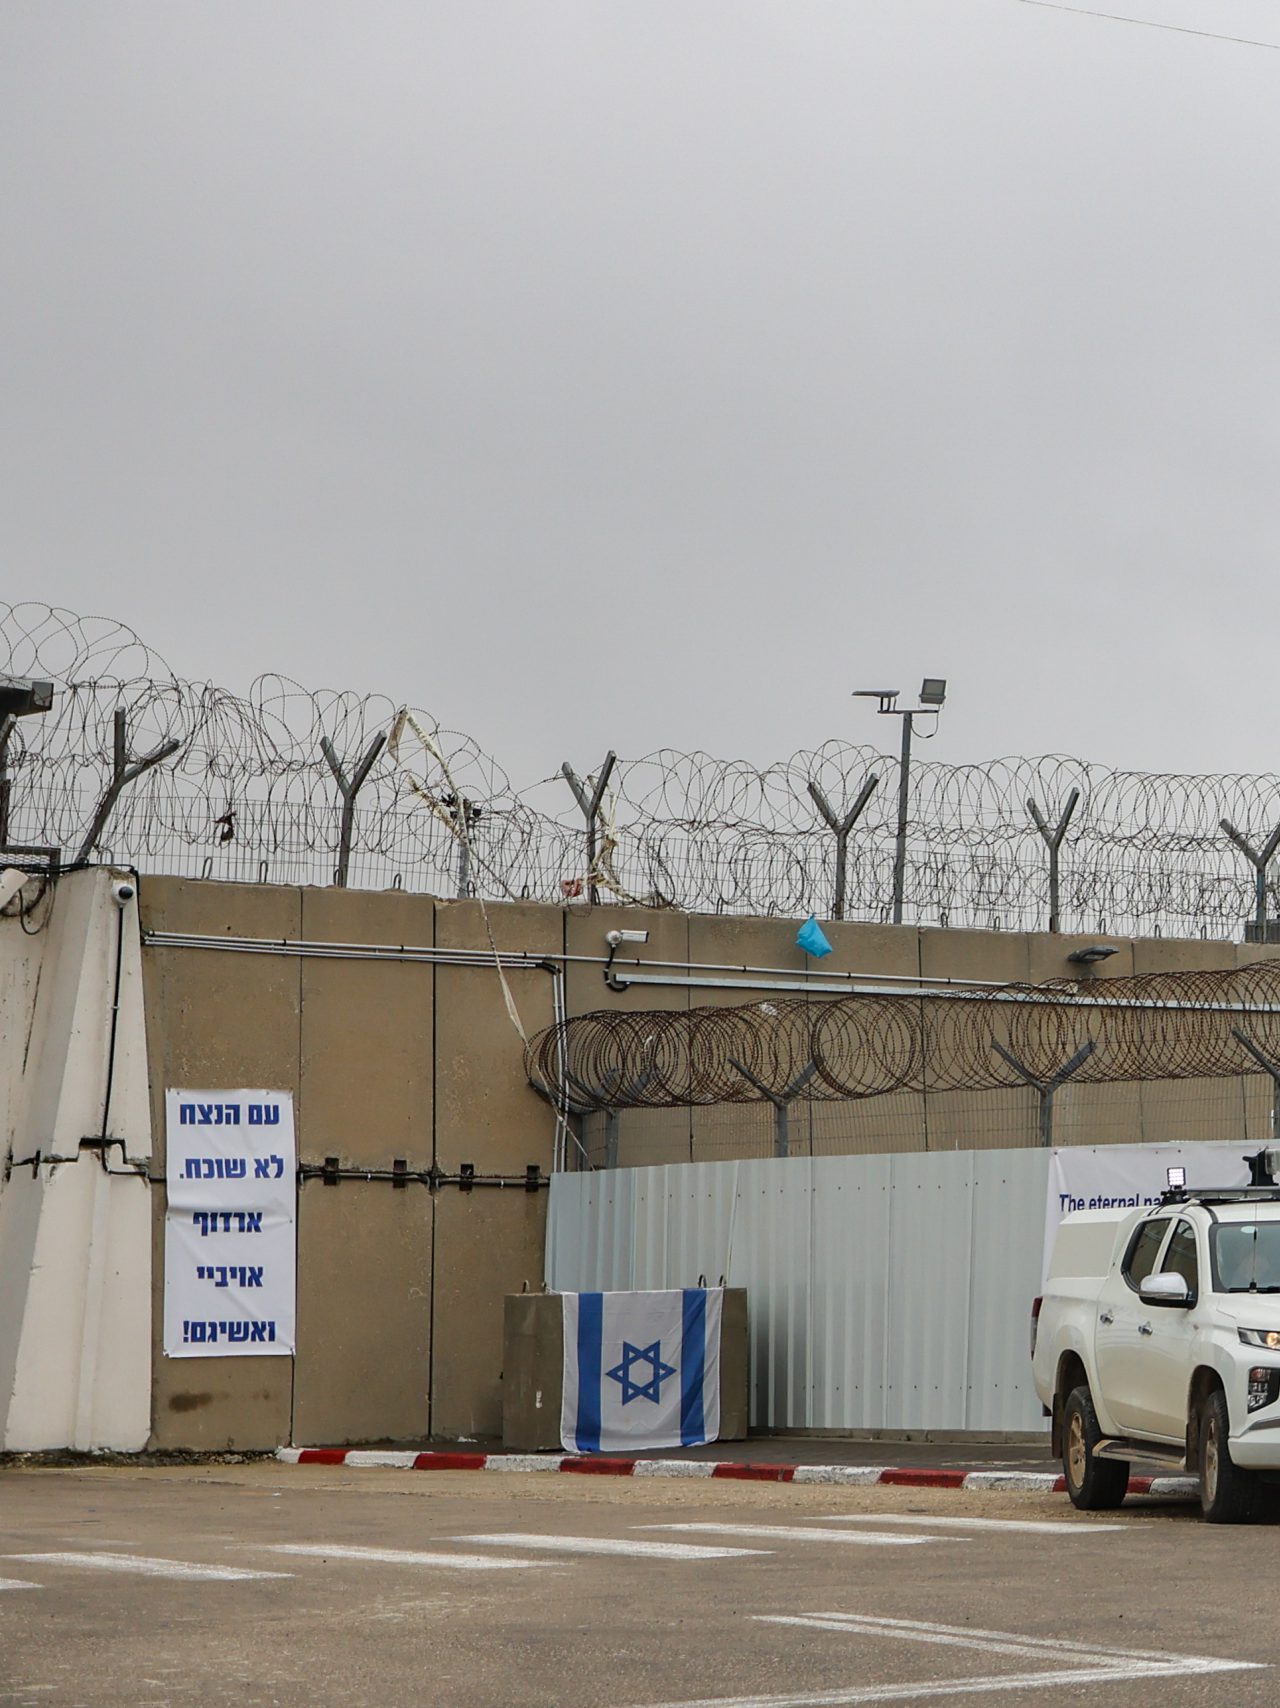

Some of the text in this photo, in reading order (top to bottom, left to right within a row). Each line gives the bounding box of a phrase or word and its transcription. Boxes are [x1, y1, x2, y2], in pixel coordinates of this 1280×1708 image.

[179, 1104, 280, 1126] עם הנצח
[179, 1155, 284, 1179] לא שוכח.
[1059, 1194, 1085, 1212] The
[1088, 1193, 1140, 1209] eternal
[192, 1212, 263, 1237] ארדוף
[196, 1266, 264, 1288] אויביי
[183, 1320, 276, 1343] ואשיגם!
